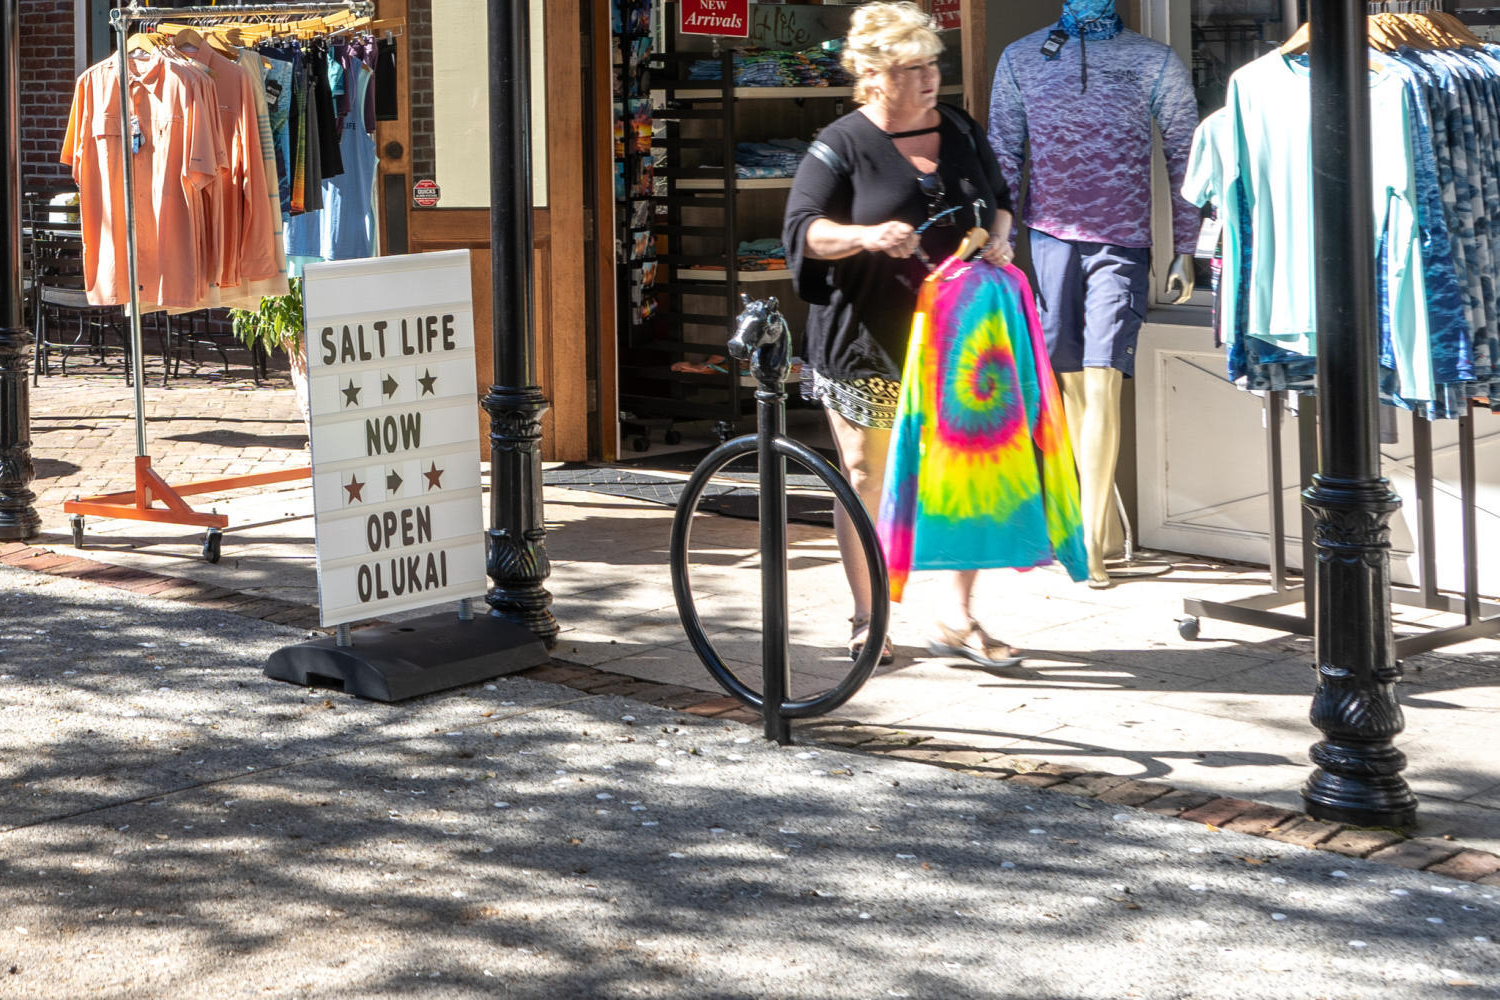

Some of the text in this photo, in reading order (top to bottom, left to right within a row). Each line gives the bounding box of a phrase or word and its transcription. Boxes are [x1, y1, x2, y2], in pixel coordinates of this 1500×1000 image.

[684, 11, 743, 28] Arrivals
[700, 0, 728, 10] NEW
[321, 314, 456, 366] SALT LIFE
[365, 411, 421, 456] NOW
[366, 504, 432, 553] OPEN
[357, 550, 448, 603] OLUKAI
